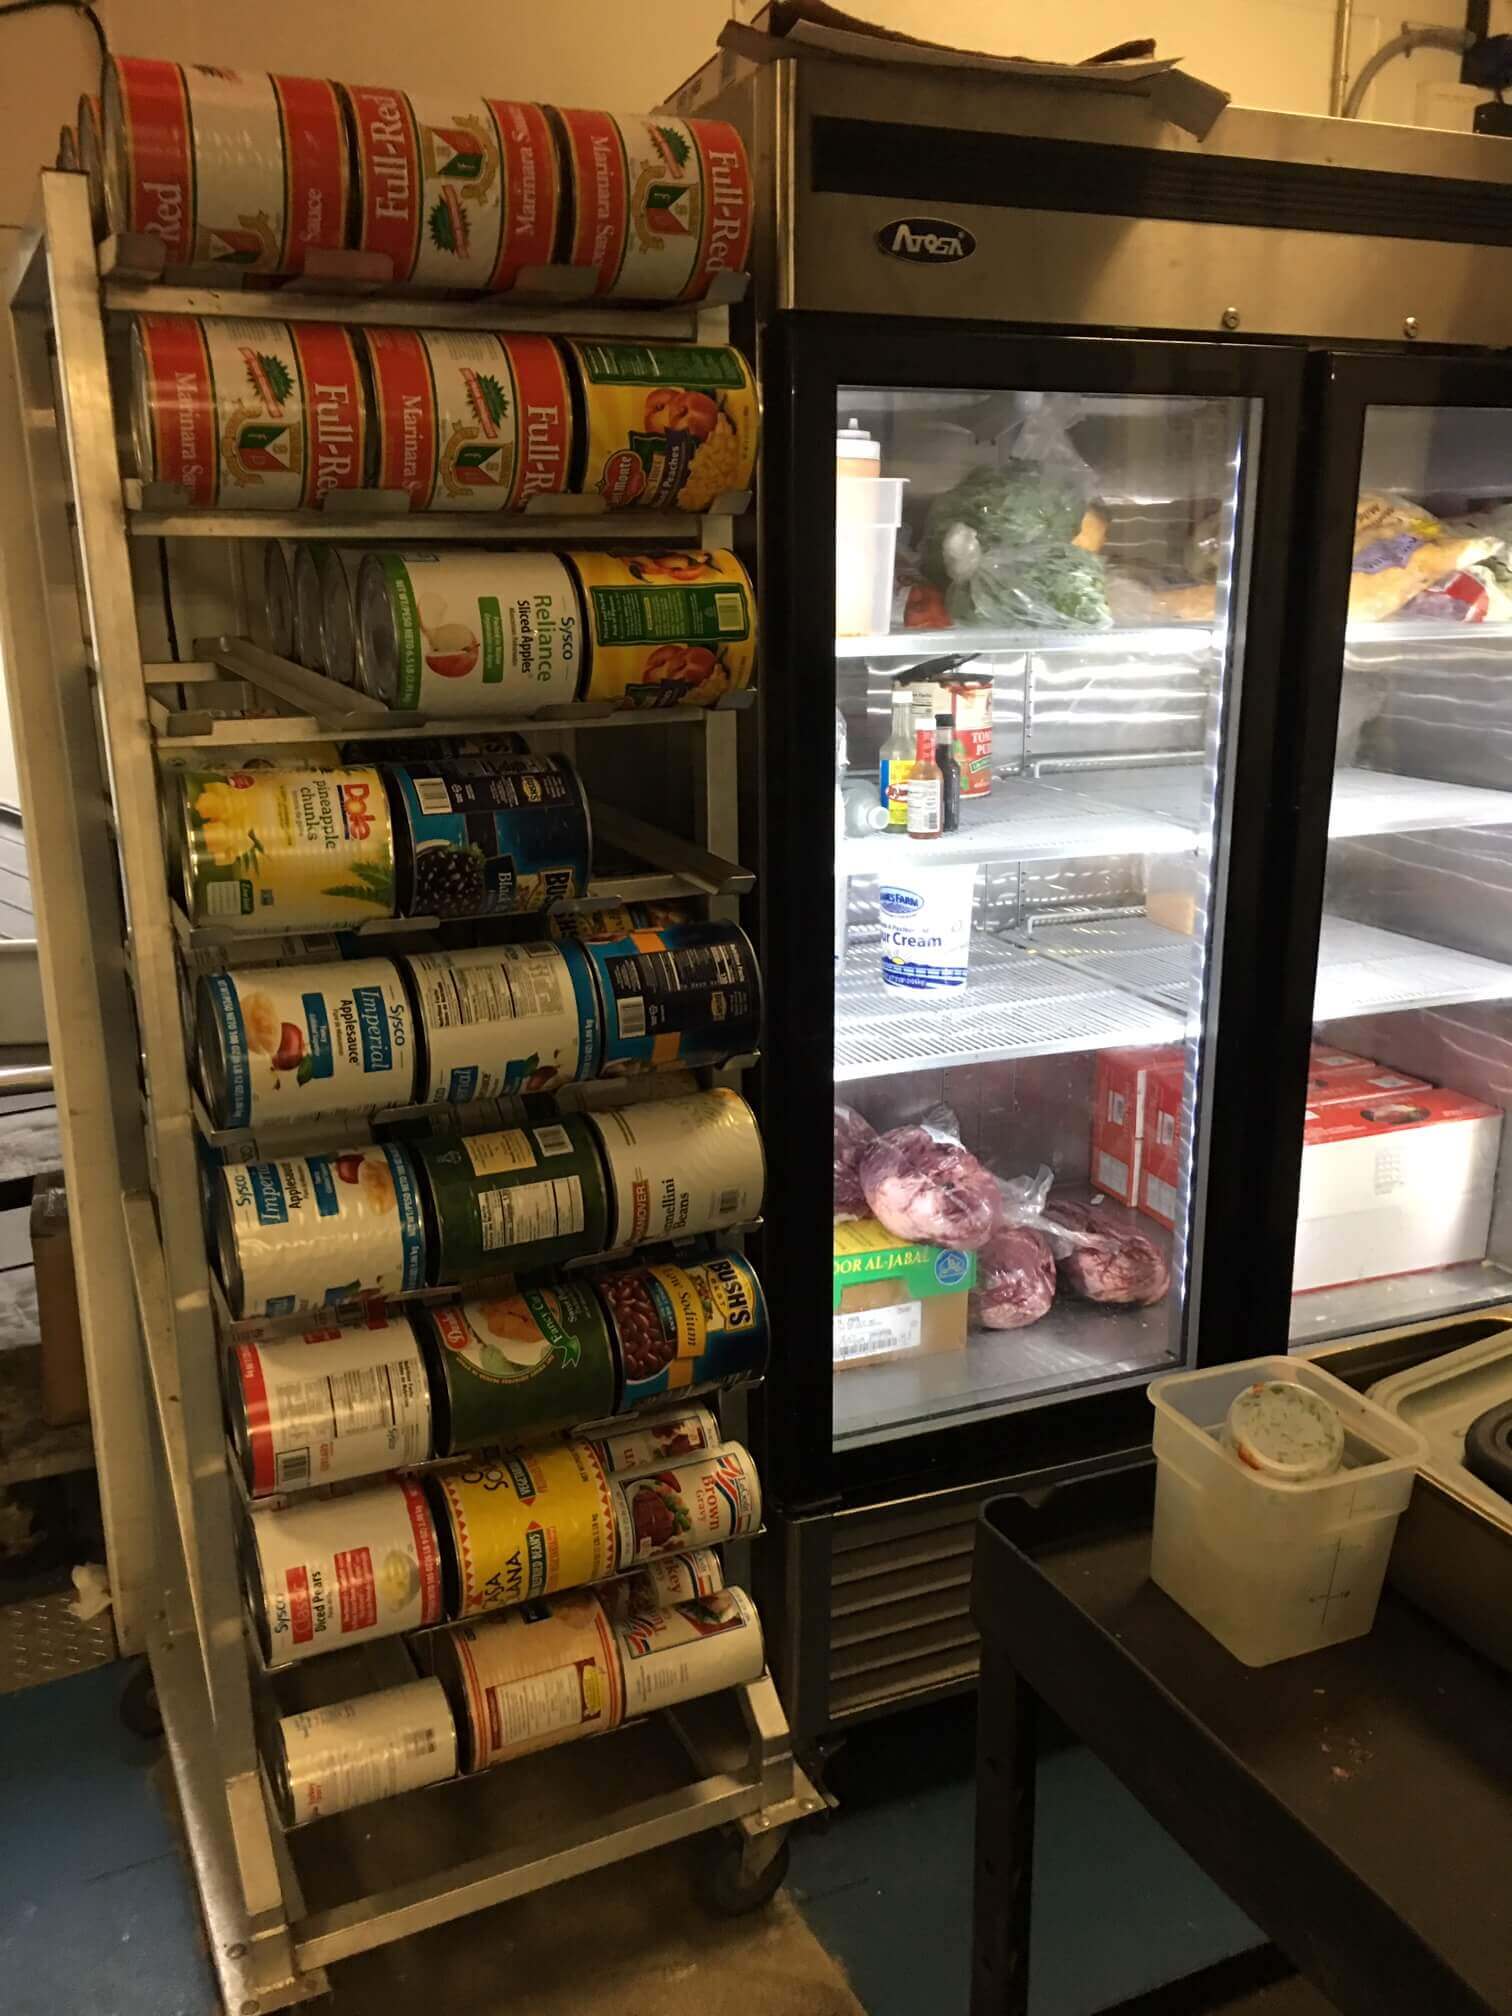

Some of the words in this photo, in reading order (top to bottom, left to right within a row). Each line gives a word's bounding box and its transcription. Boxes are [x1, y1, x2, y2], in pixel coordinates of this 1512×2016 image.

[362, 95, 409, 221] Full-Red
[591, 133, 614, 217] Marinara
[515, 145, 535, 235] Marinara
[173, 372, 198, 461] Marinara
[401, 394, 423, 478] Marinara
[665, 446, 680, 489] Peaches
[517, 599, 530, 633] Sliced
[533, 594, 556, 682] Reliance
[560, 616, 575, 660] Sysco
[521, 634, 535, 674] Apples
[300, 786, 318, 841] chunks
[313, 780, 340, 849] pineapple
[343, 783, 376, 841] Dole
[892, 931, 943, 948] Cream
[340, 999, 360, 1064] Applesauce
[360, 990, 386, 1071] Imperial
[390, 1003, 406, 1046] Sysco
[234, 1174, 252, 1207] Sysco
[673, 1191, 690, 1232] Beans
[864, 1251, 930, 1271] AL-JABAL
[679, 1290, 698, 1347] Sodium
[707, 1260, 751, 1326] BUSH'S
[694, 1488, 707, 1521] Gravy
[701, 1474, 721, 1531] Brown
[312, 1602, 328, 1633] Diced
